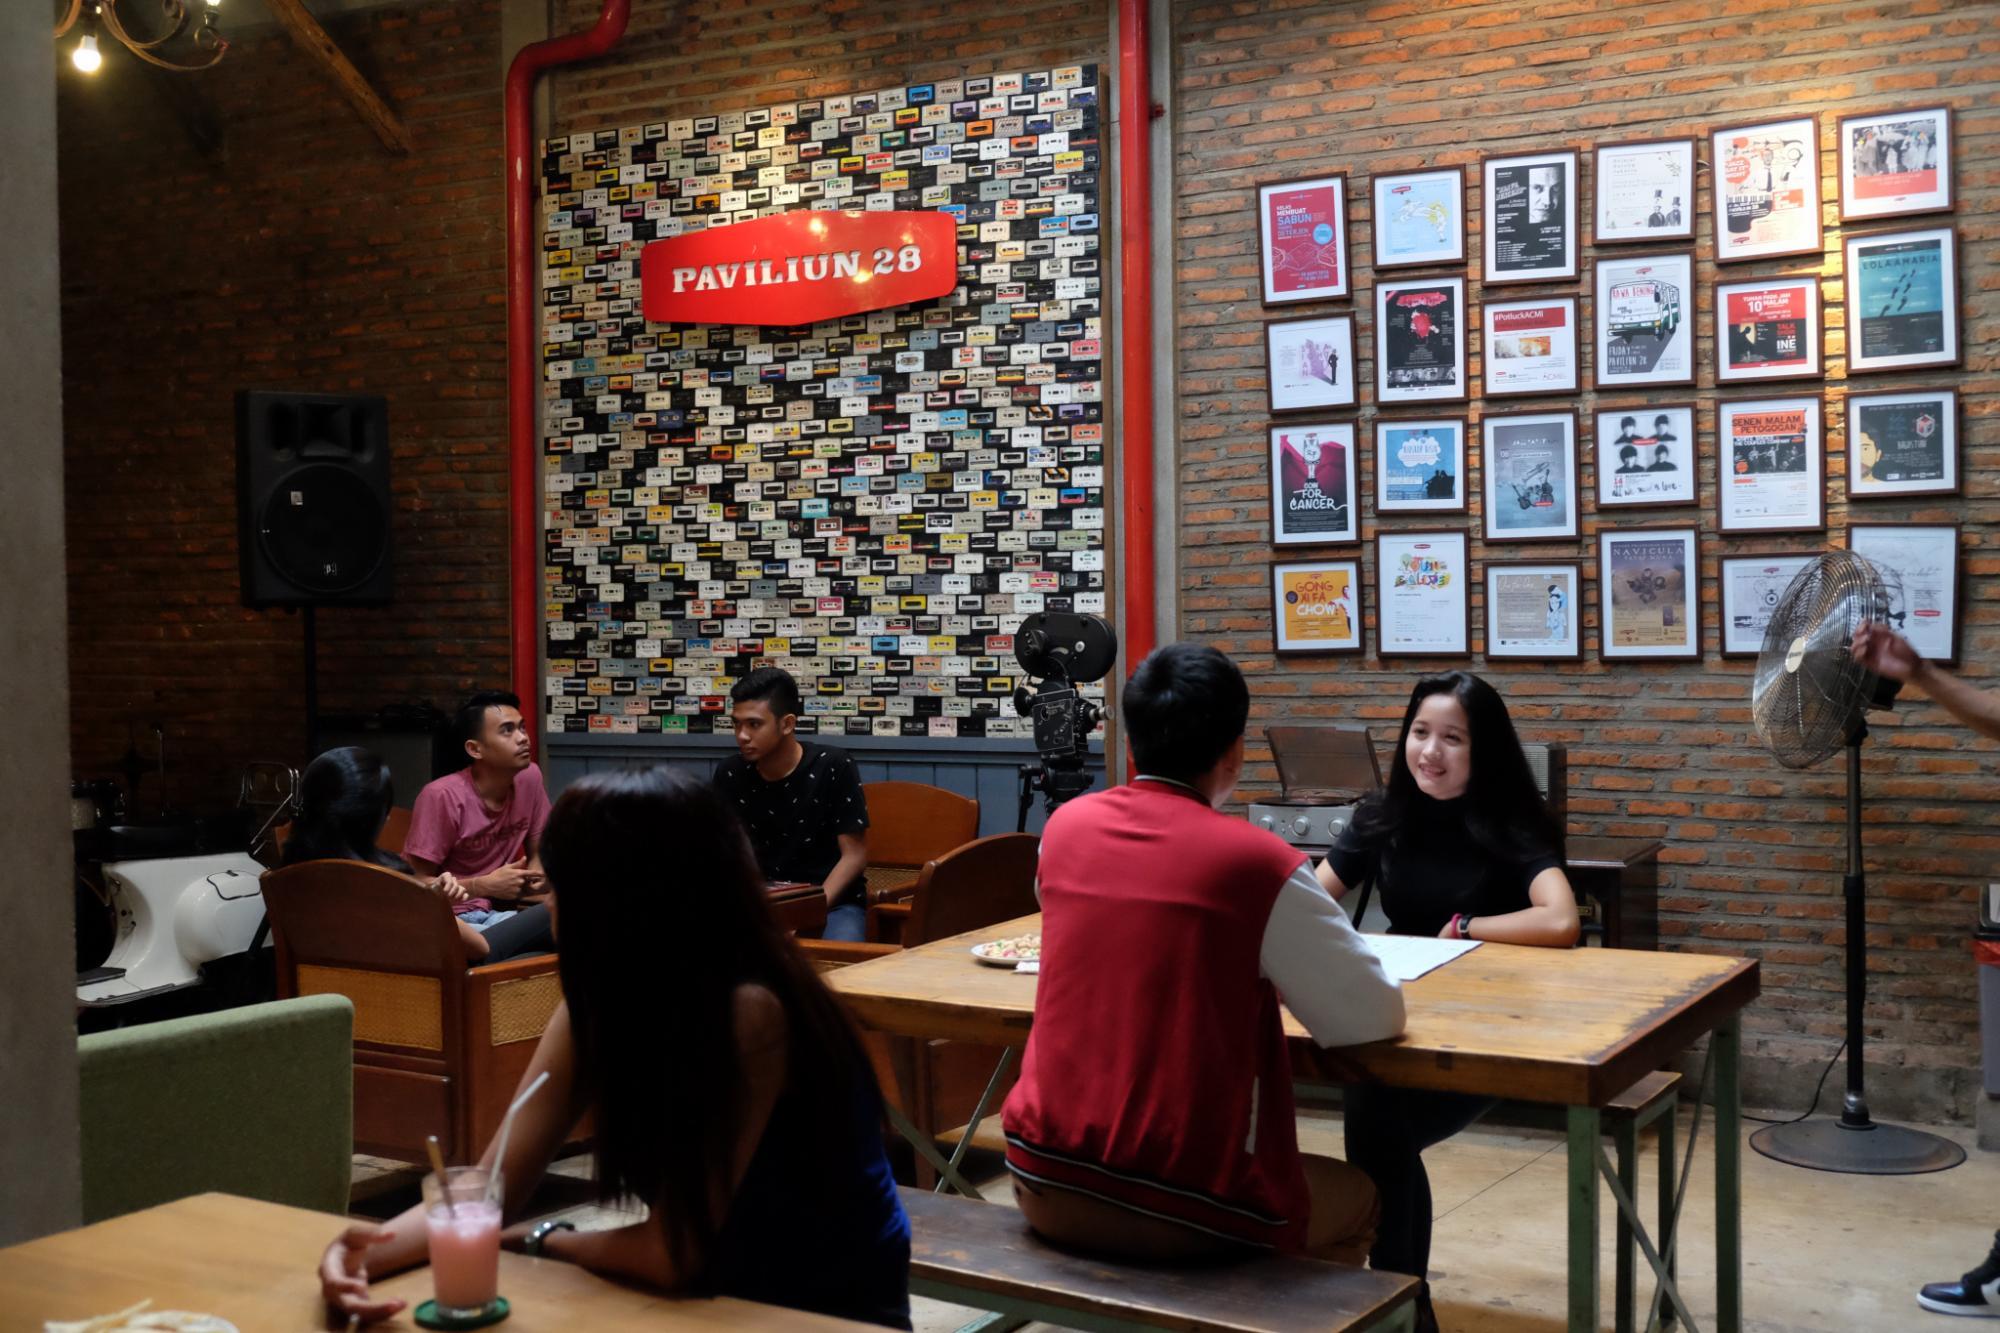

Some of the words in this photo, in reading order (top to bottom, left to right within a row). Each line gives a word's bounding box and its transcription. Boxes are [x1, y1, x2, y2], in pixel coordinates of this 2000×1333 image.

[1276, 208, 1307, 216] MEMBUAT
[1278, 214, 1312, 225] SABUN
[672, 250, 861, 293] PAVILIUN
[872, 245, 922, 275] 28
[1748, 301, 1762, 313] 10
[1765, 415, 1801, 424] MALAM
[1741, 424, 1797, 433] PETOGOGAN
[1302, 489, 1327, 498] FOR
[1613, 547, 1684, 556] NAVICULA
[1296, 581, 1333, 592] GONG
